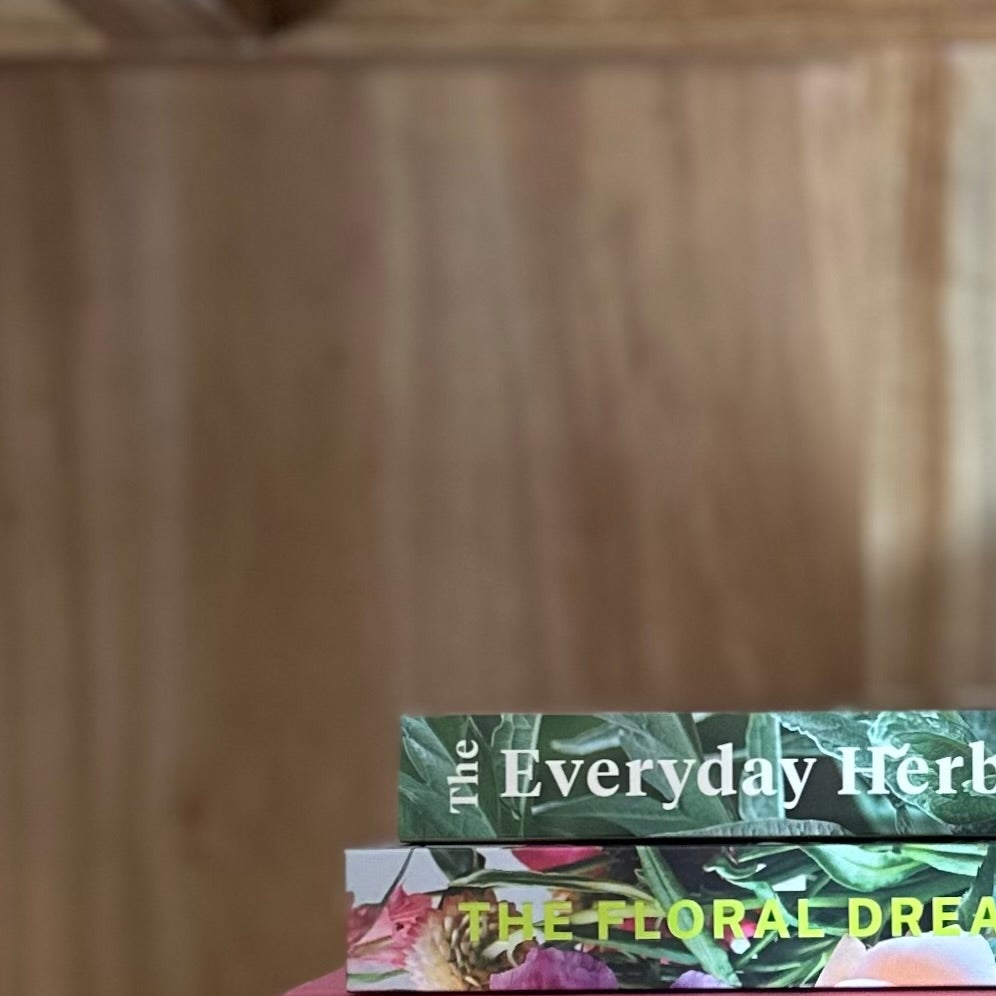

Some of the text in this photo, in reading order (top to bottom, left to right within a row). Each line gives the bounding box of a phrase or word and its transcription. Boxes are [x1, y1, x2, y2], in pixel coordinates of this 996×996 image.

[446, 738, 479, 814] The
[500, 743, 817, 811] Everyday
[459, 900, 572, 942] THE
[598, 898, 825, 941] FLORAL
